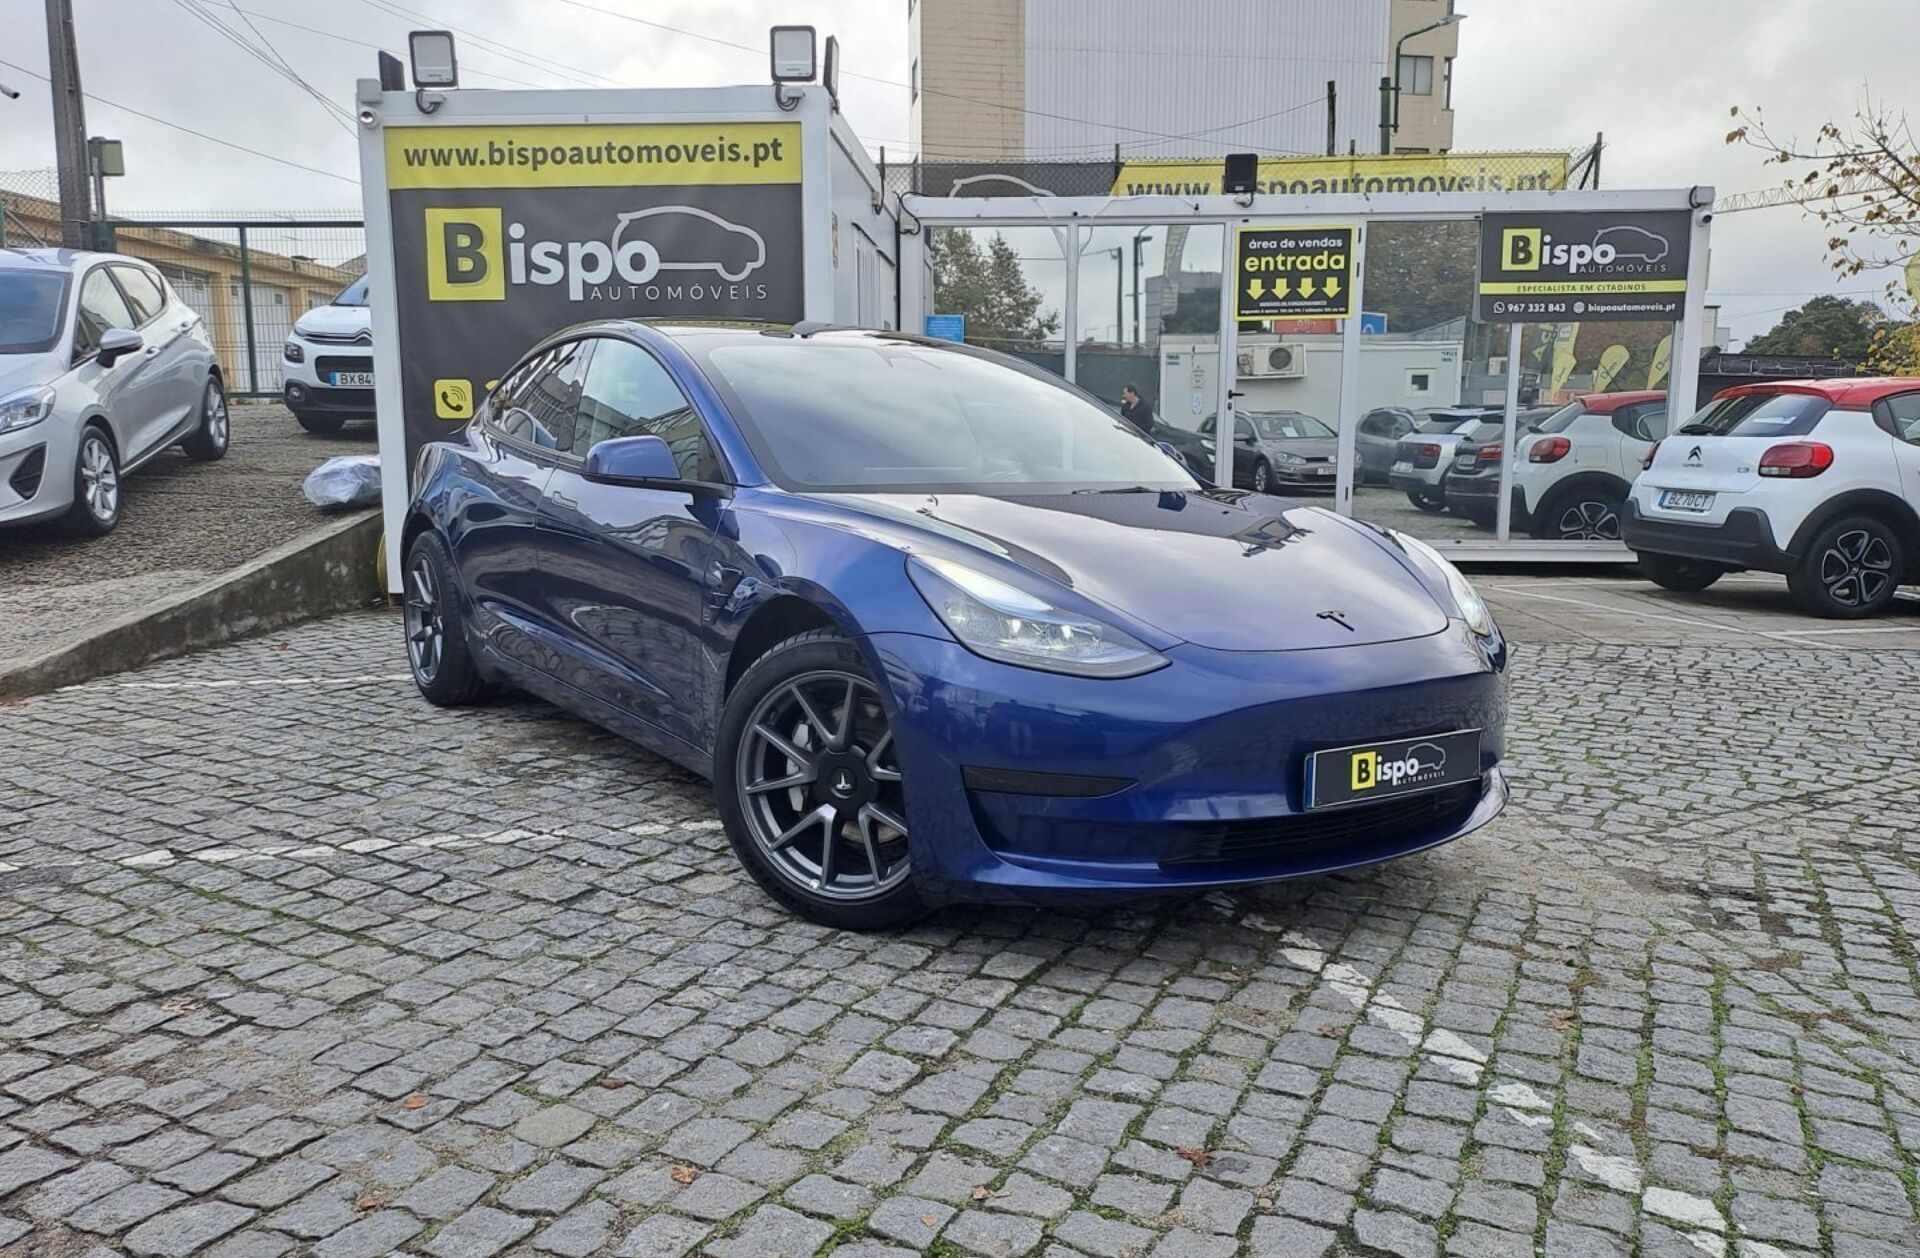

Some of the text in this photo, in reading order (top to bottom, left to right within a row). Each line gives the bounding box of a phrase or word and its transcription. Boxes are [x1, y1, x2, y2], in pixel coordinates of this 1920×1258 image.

[403, 136, 783, 171] www.bispoautomoveis.pt
[1248, 237, 1343, 250] área de vendas
[443, 222, 661, 301] Bispo
[1244, 250, 1345, 272] entrada
[1510, 234, 1616, 274] Bispo
[1579, 263, 1667, 274] AUTOMÓVEIS
[590, 282, 768, 301] AUTOMÓVEIS
[1517, 283, 1646, 293] ESPECIALISTA EM CITADINOS
[1507, 302, 1676, 313] 967 332 843 bispoautomoveis.pt
[1357, 755, 1420, 786] Bispo
